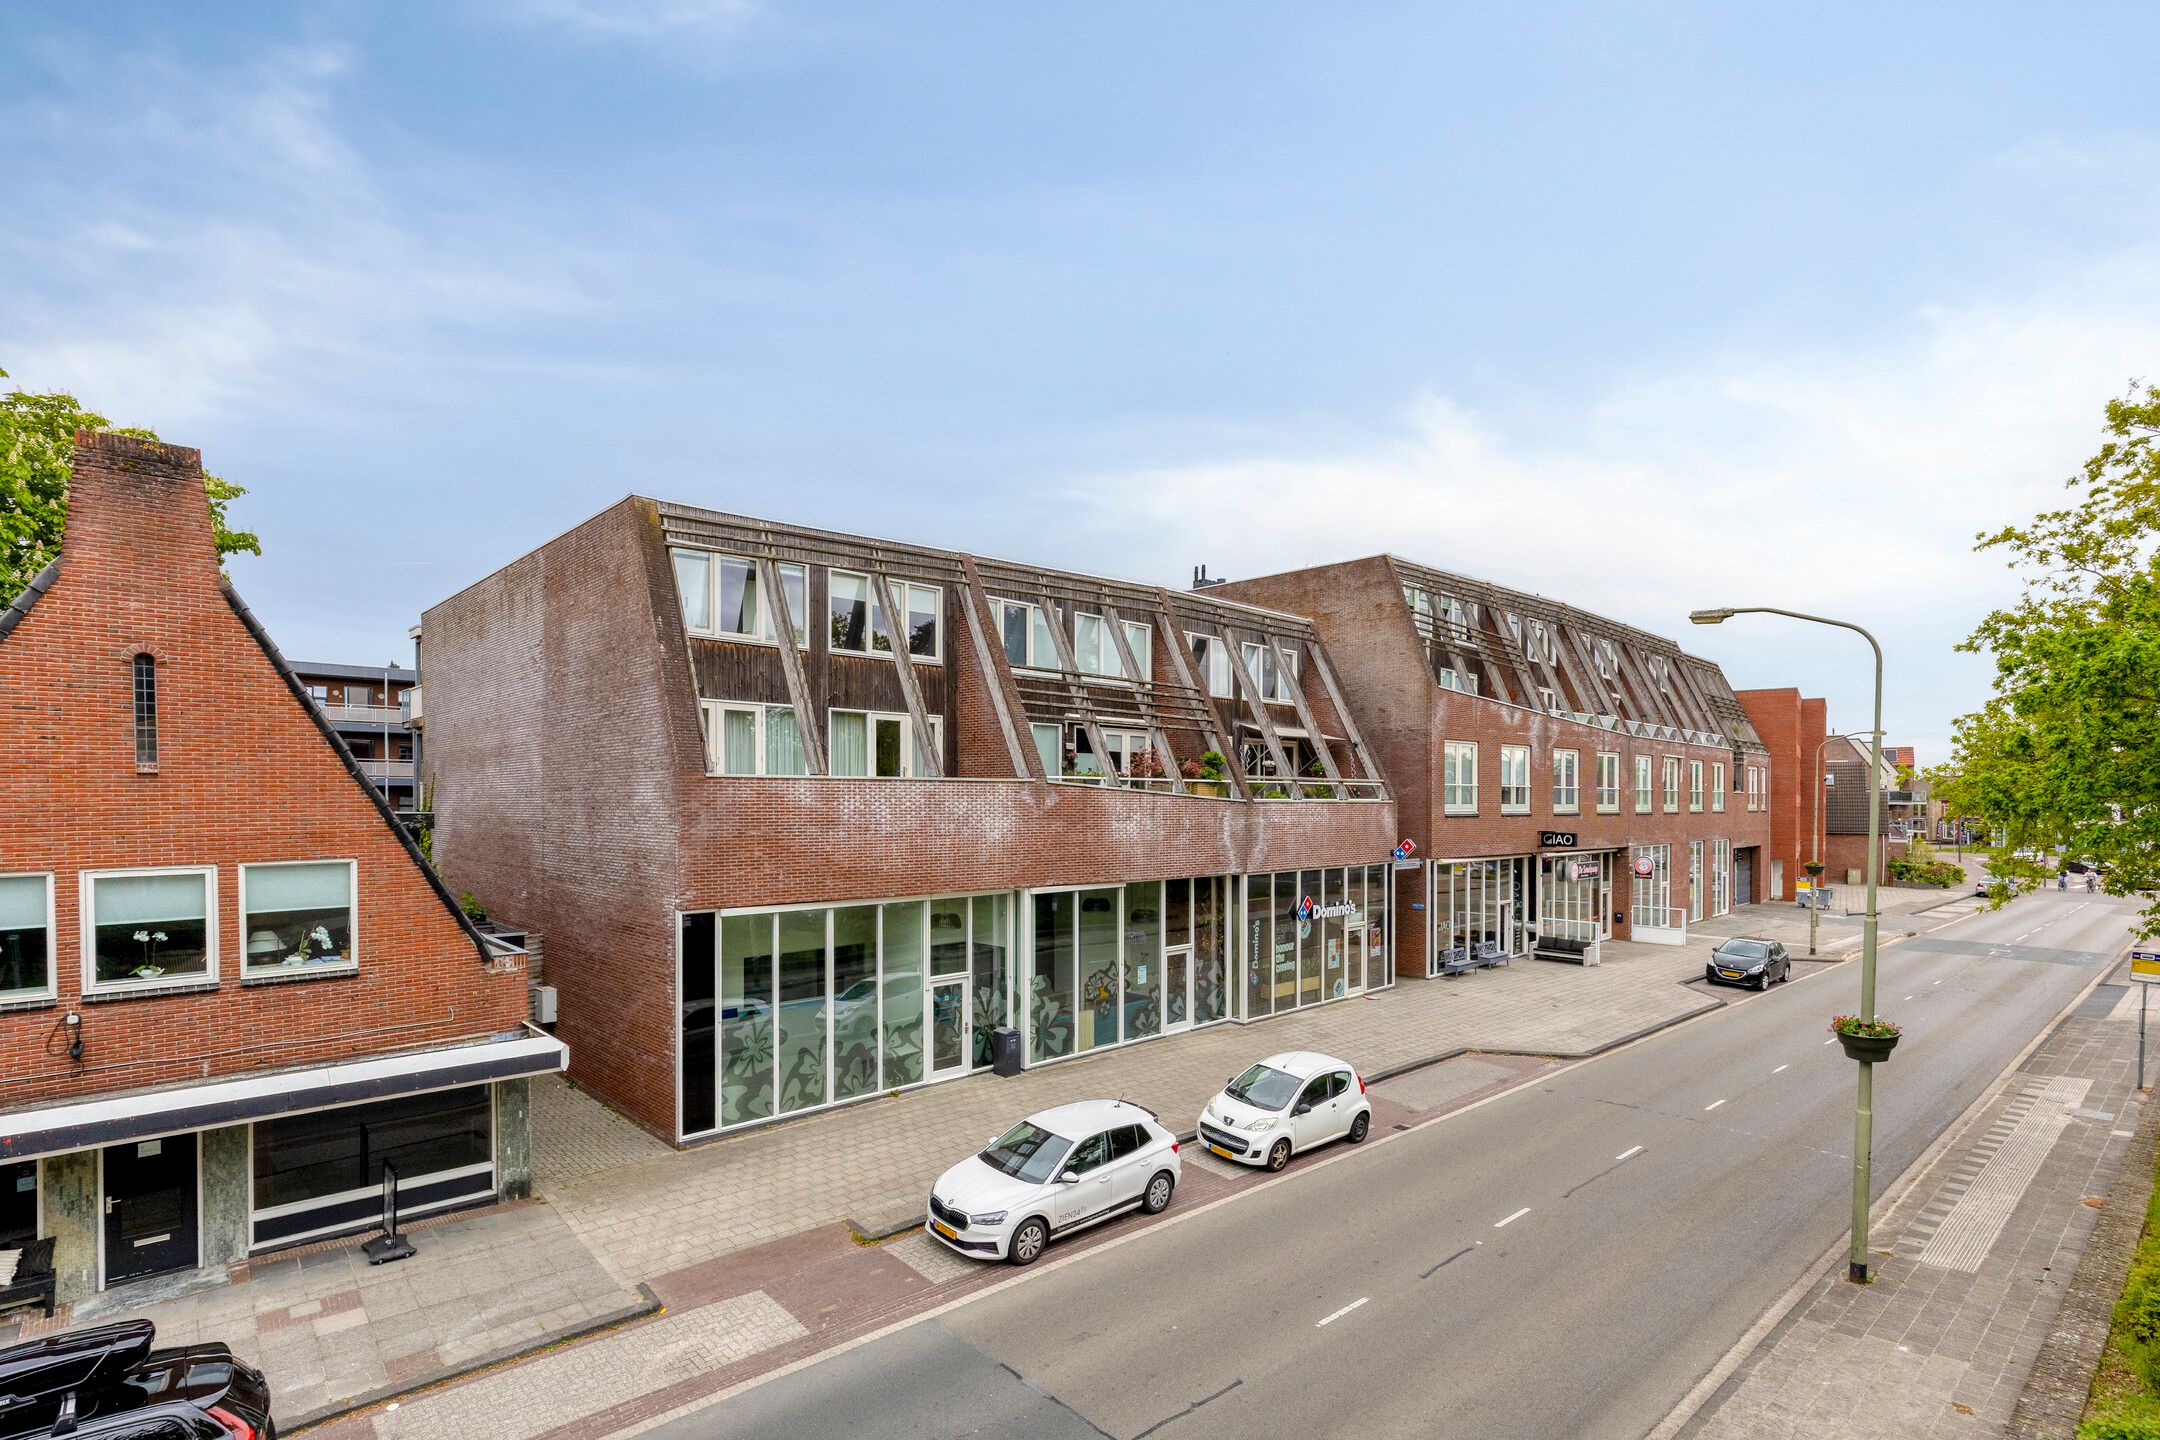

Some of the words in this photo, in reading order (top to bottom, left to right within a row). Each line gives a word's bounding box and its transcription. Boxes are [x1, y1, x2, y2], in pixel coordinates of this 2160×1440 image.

[1543, 833, 1573, 845] GIAO
[1313, 900, 1356, 920] Domino's
[1252, 920, 1260, 969] Domino's
[1058, 1209, 1080, 1223] ZIEN24
